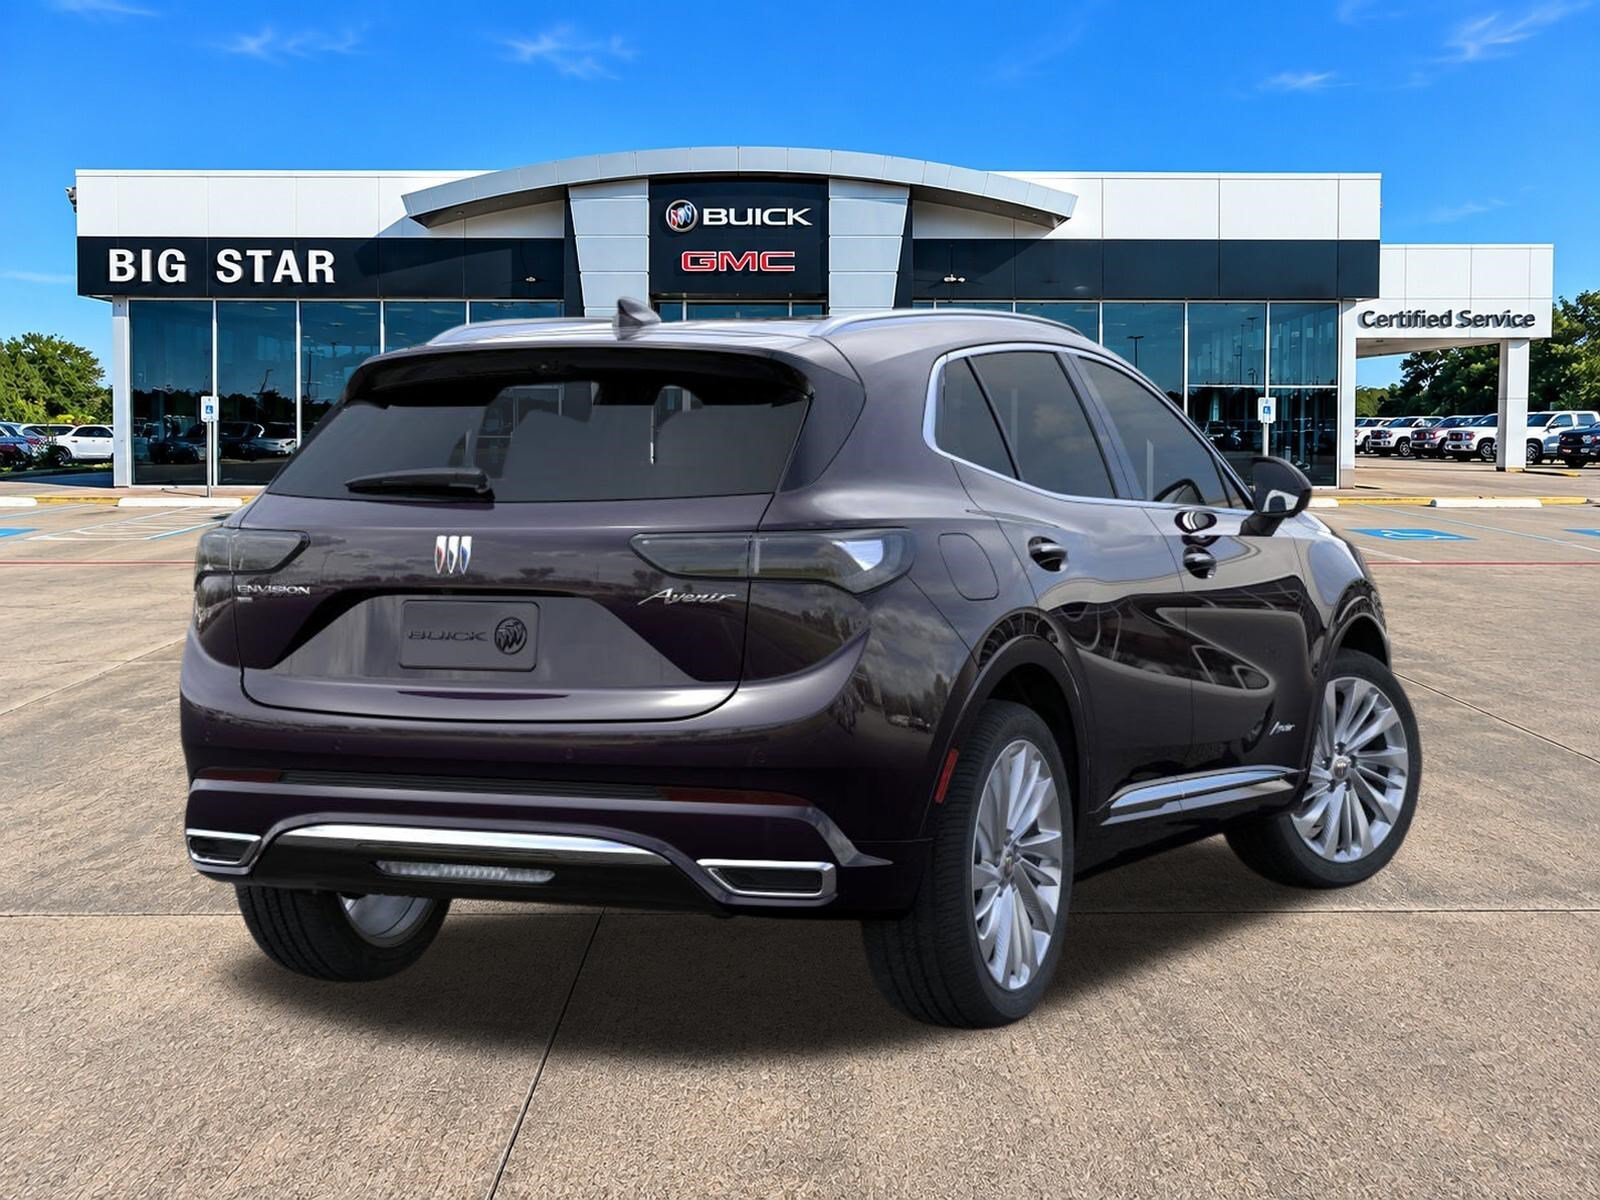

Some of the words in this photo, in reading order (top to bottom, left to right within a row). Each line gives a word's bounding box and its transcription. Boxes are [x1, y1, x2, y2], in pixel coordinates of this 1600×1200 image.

[703, 207, 813, 226] BUICK
[108, 248, 187, 283] BIG
[215, 248, 336, 284] STAR
[681, 250, 796, 272] GMC
[1359, 309, 1452, 328] Certified
[1457, 309, 1536, 328] Service
[237, 584, 311, 595] ENVISION
[637, 587, 737, 605] Avenir
[408, 630, 488, 641] BUICK
